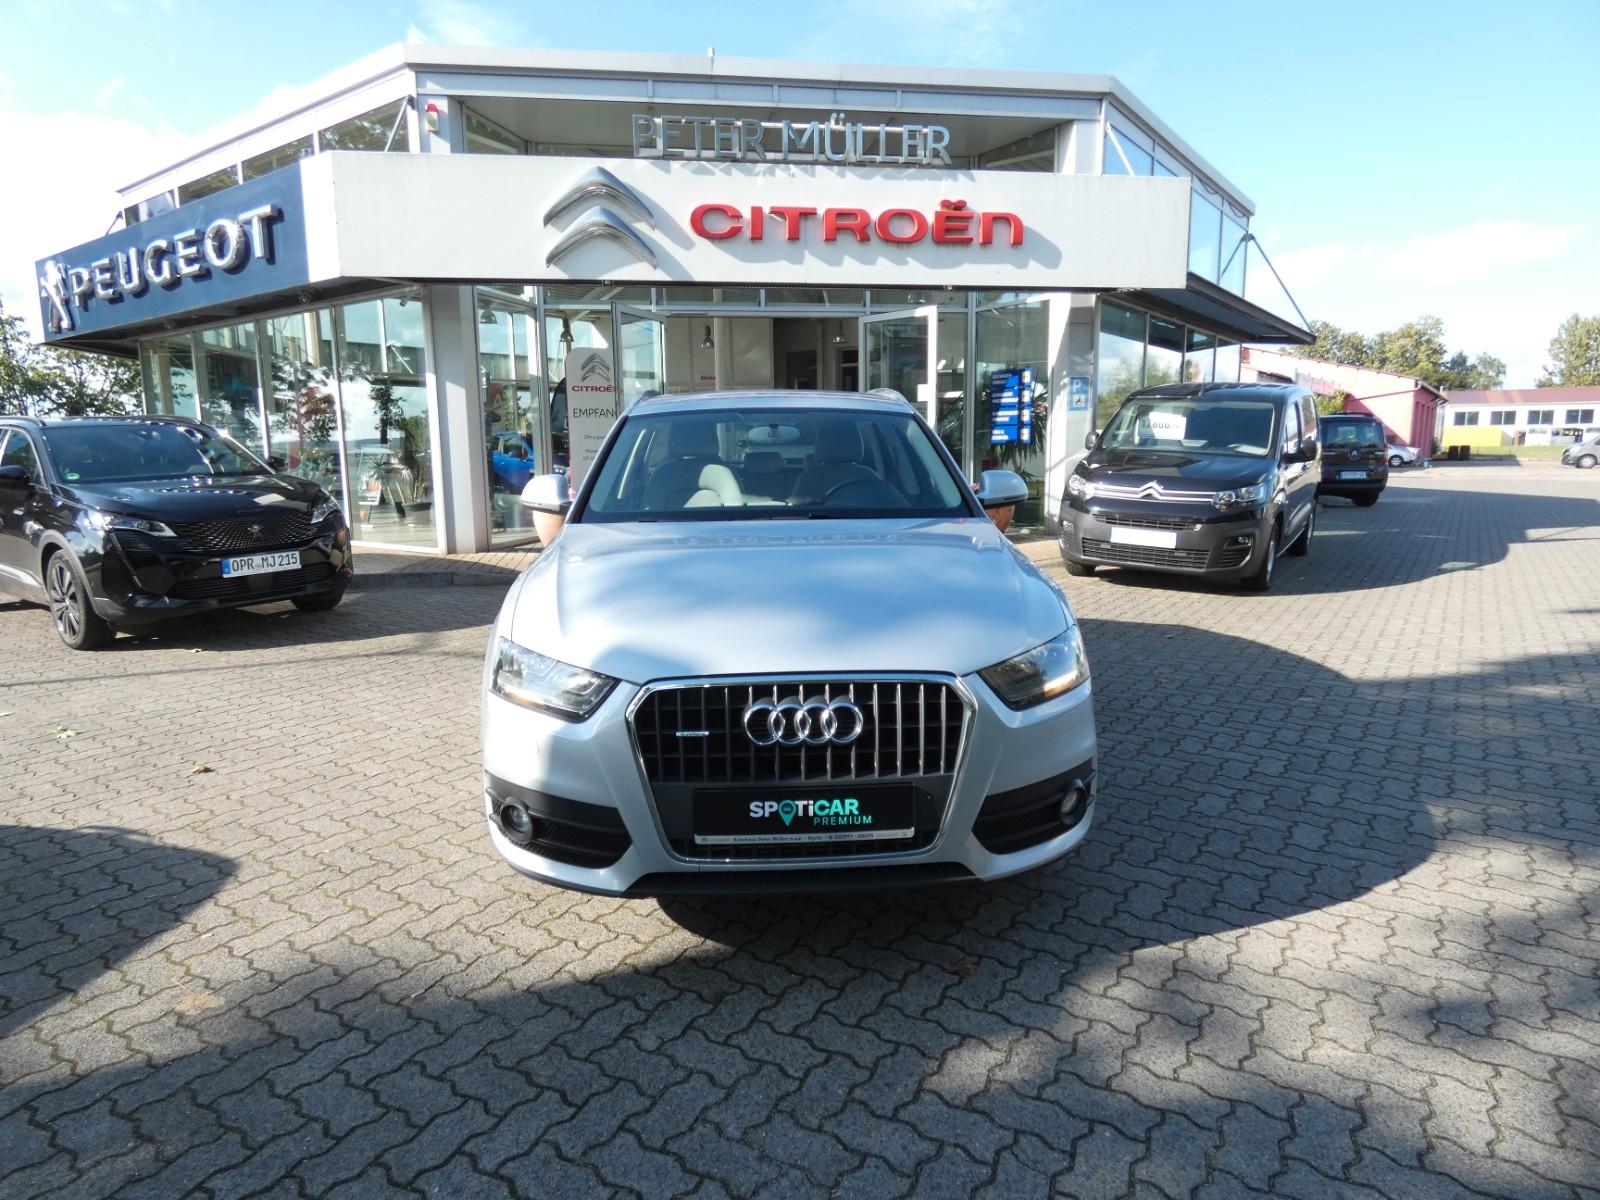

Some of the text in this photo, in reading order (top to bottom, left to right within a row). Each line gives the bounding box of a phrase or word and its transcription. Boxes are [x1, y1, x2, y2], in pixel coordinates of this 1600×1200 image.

[632, 112, 952, 165] PETER MÜLLER
[69, 204, 281, 309] PEUGEOT
[232, 558, 254, 571] OPR
[278, 553, 298, 566] 215
[813, 815, 873, 826] PREMIUM
